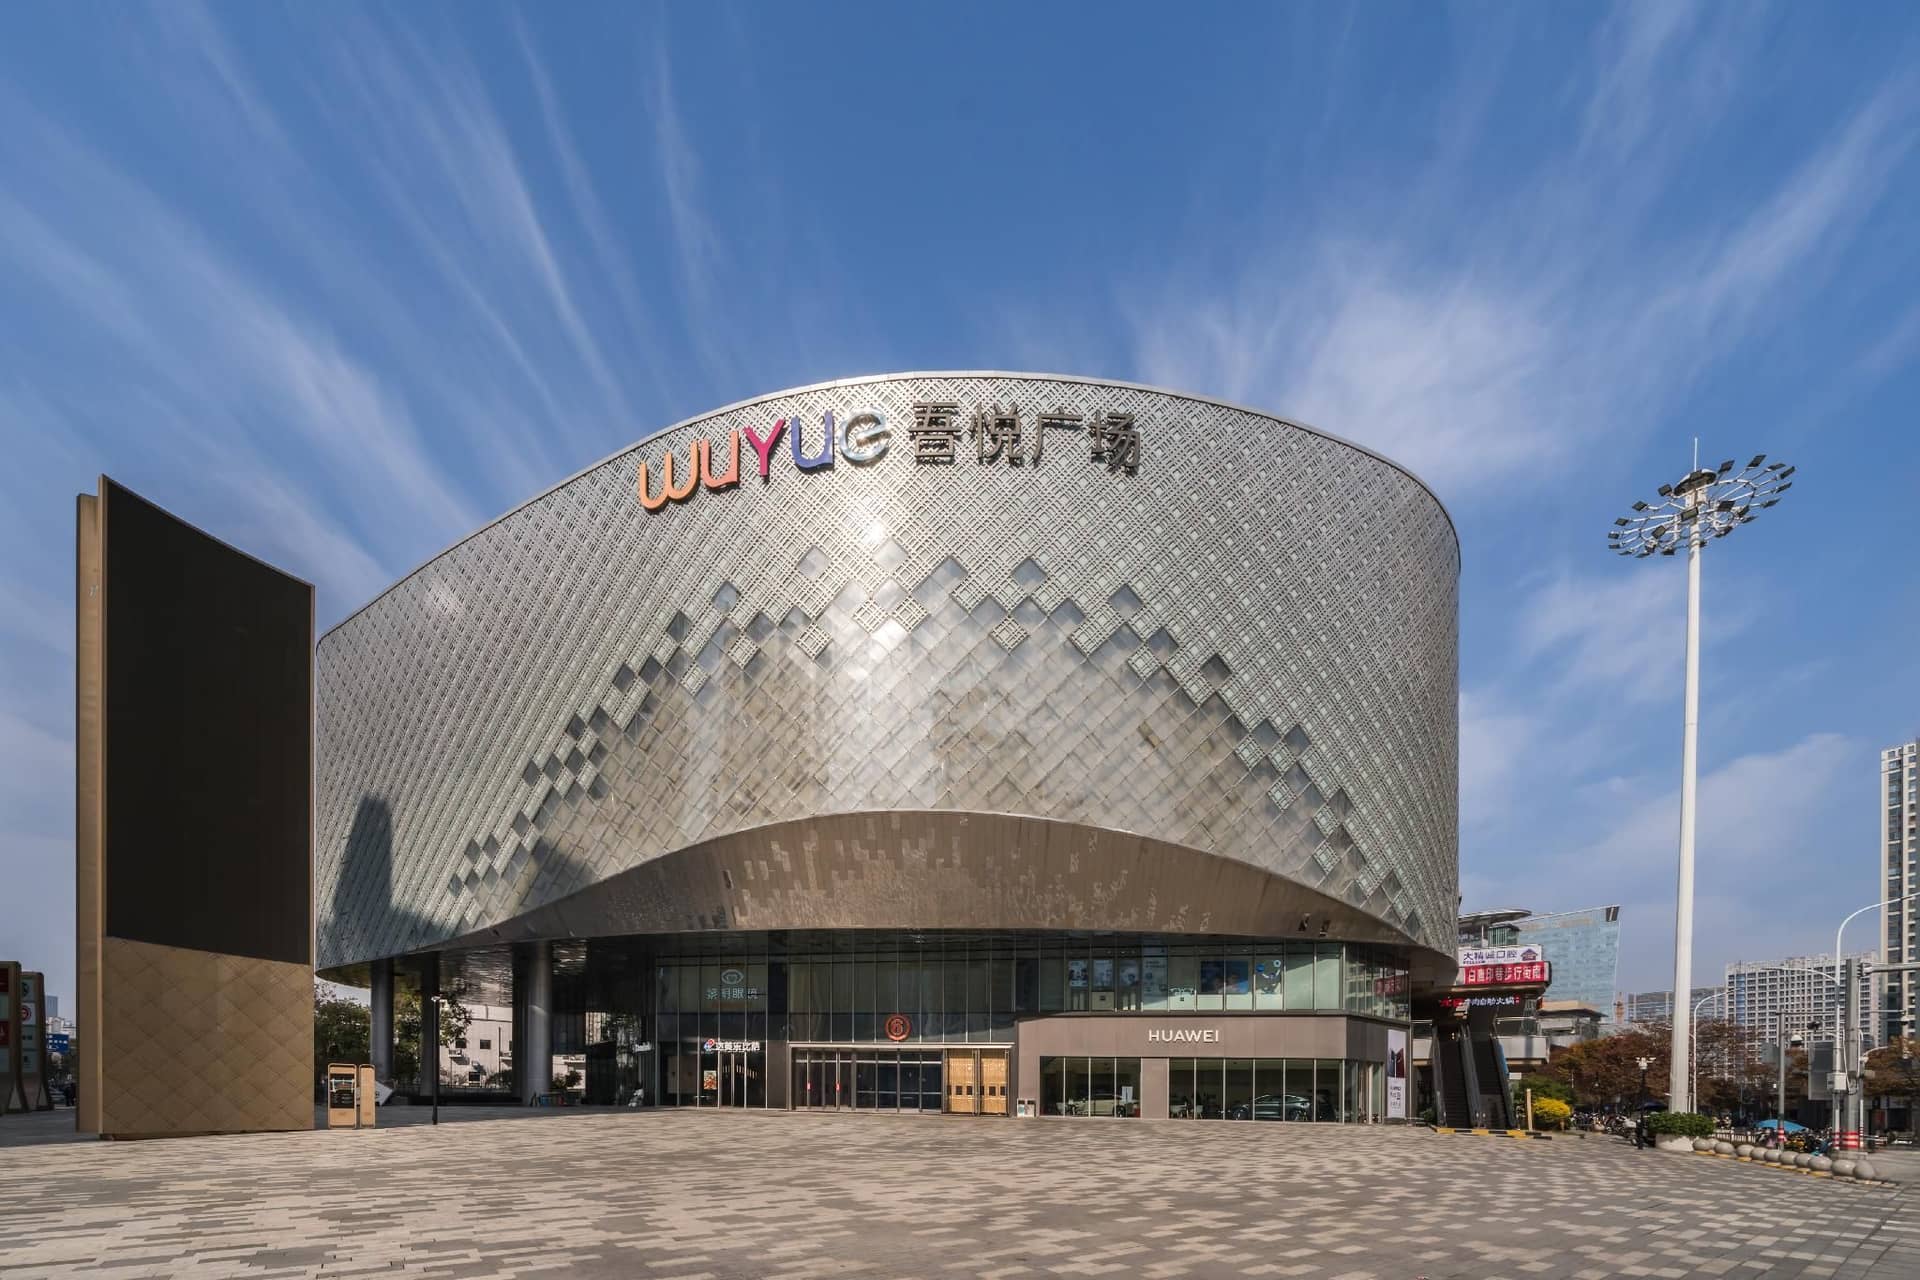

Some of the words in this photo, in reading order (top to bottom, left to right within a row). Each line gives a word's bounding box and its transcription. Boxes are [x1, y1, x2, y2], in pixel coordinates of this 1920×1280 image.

[909, 402, 1141, 468] 吾悦广场
[1148, 1029, 1219, 1042] HUAWEI
